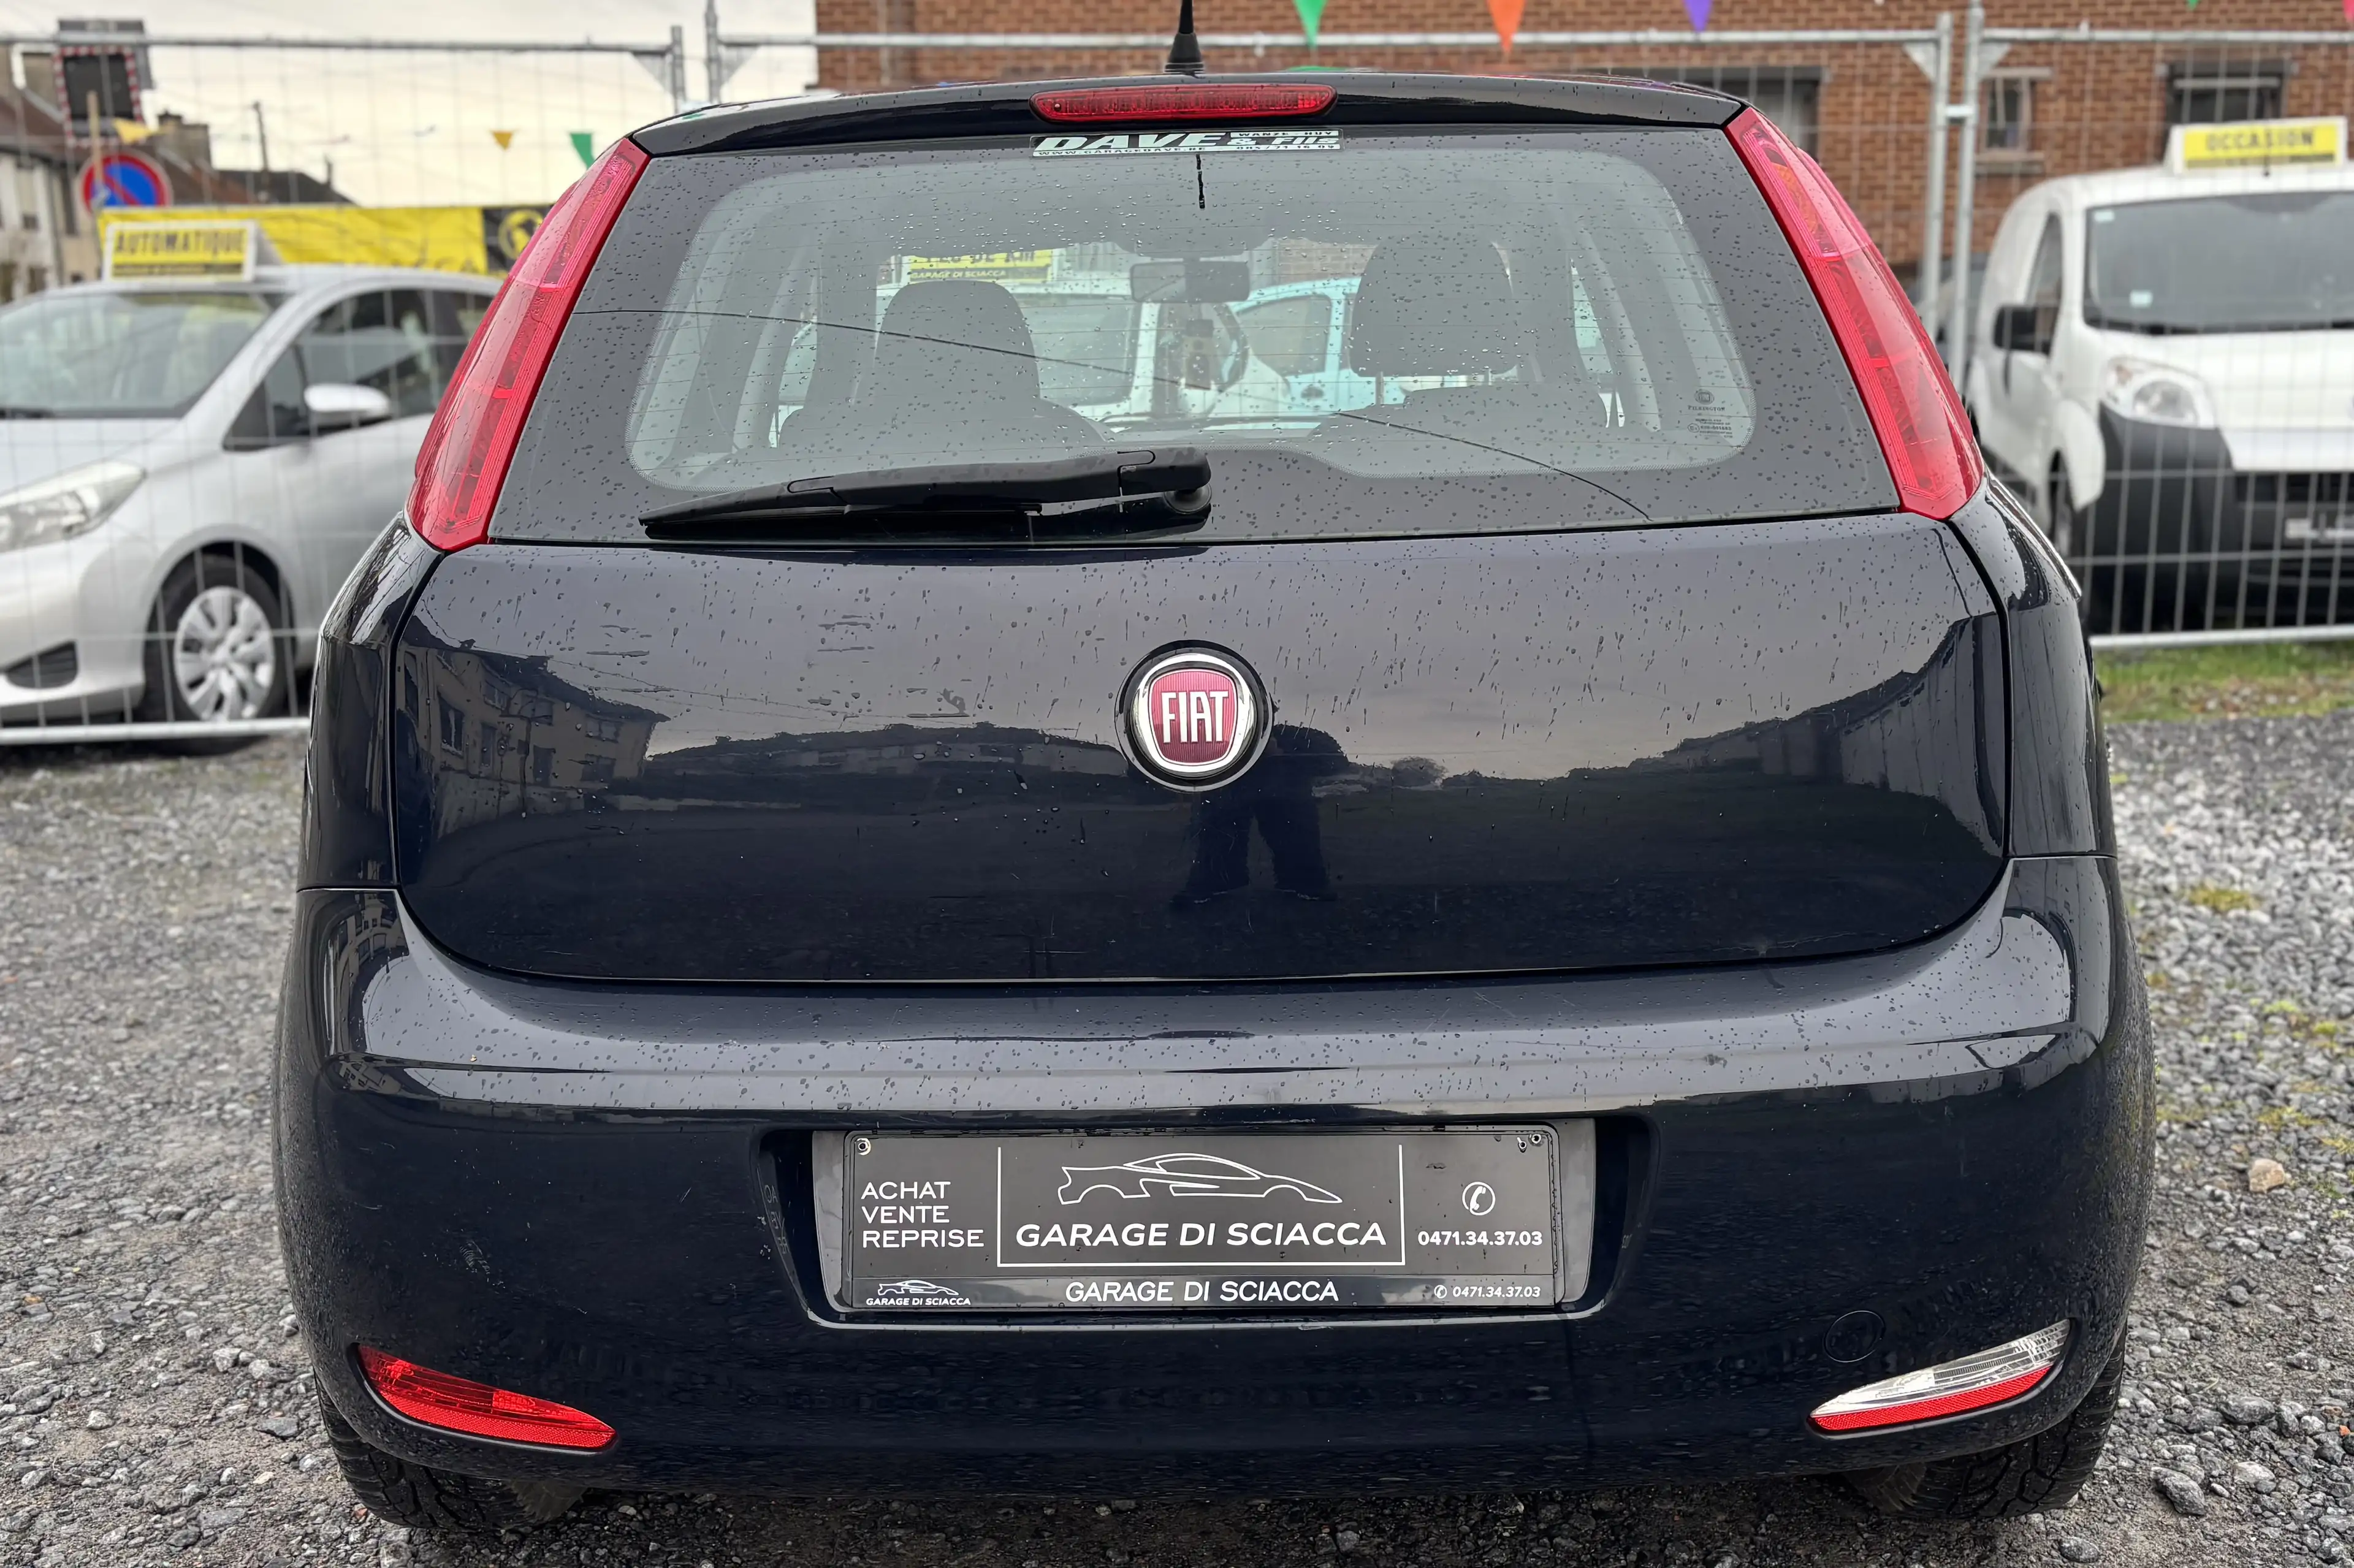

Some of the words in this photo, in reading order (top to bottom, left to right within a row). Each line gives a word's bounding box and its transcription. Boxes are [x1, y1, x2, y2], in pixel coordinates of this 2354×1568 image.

[1034, 132, 1226, 151] DAVE
[1160, 690, 1229, 744] FIAT
[861, 1181, 951, 1200] ACHAT
[861, 1205, 950, 1224] VENTE
[863, 1229, 985, 1249] REPRISE
[1016, 1223, 1169, 1247] GARAGE
[1179, 1223, 1216, 1246] DI
[1227, 1222, 1387, 1246] SCIACCA
[1417, 1230, 1544, 1246] 0471.34.37.03
[924, 1297, 971, 1306] SCIACCA
[1065, 1281, 1174, 1303] GARAGE
[1183, 1281, 1210, 1301] DI
[1219, 1281, 1339, 1301] SCIACCA
[1452, 1285, 1541, 1299] 0471.34.37.03
